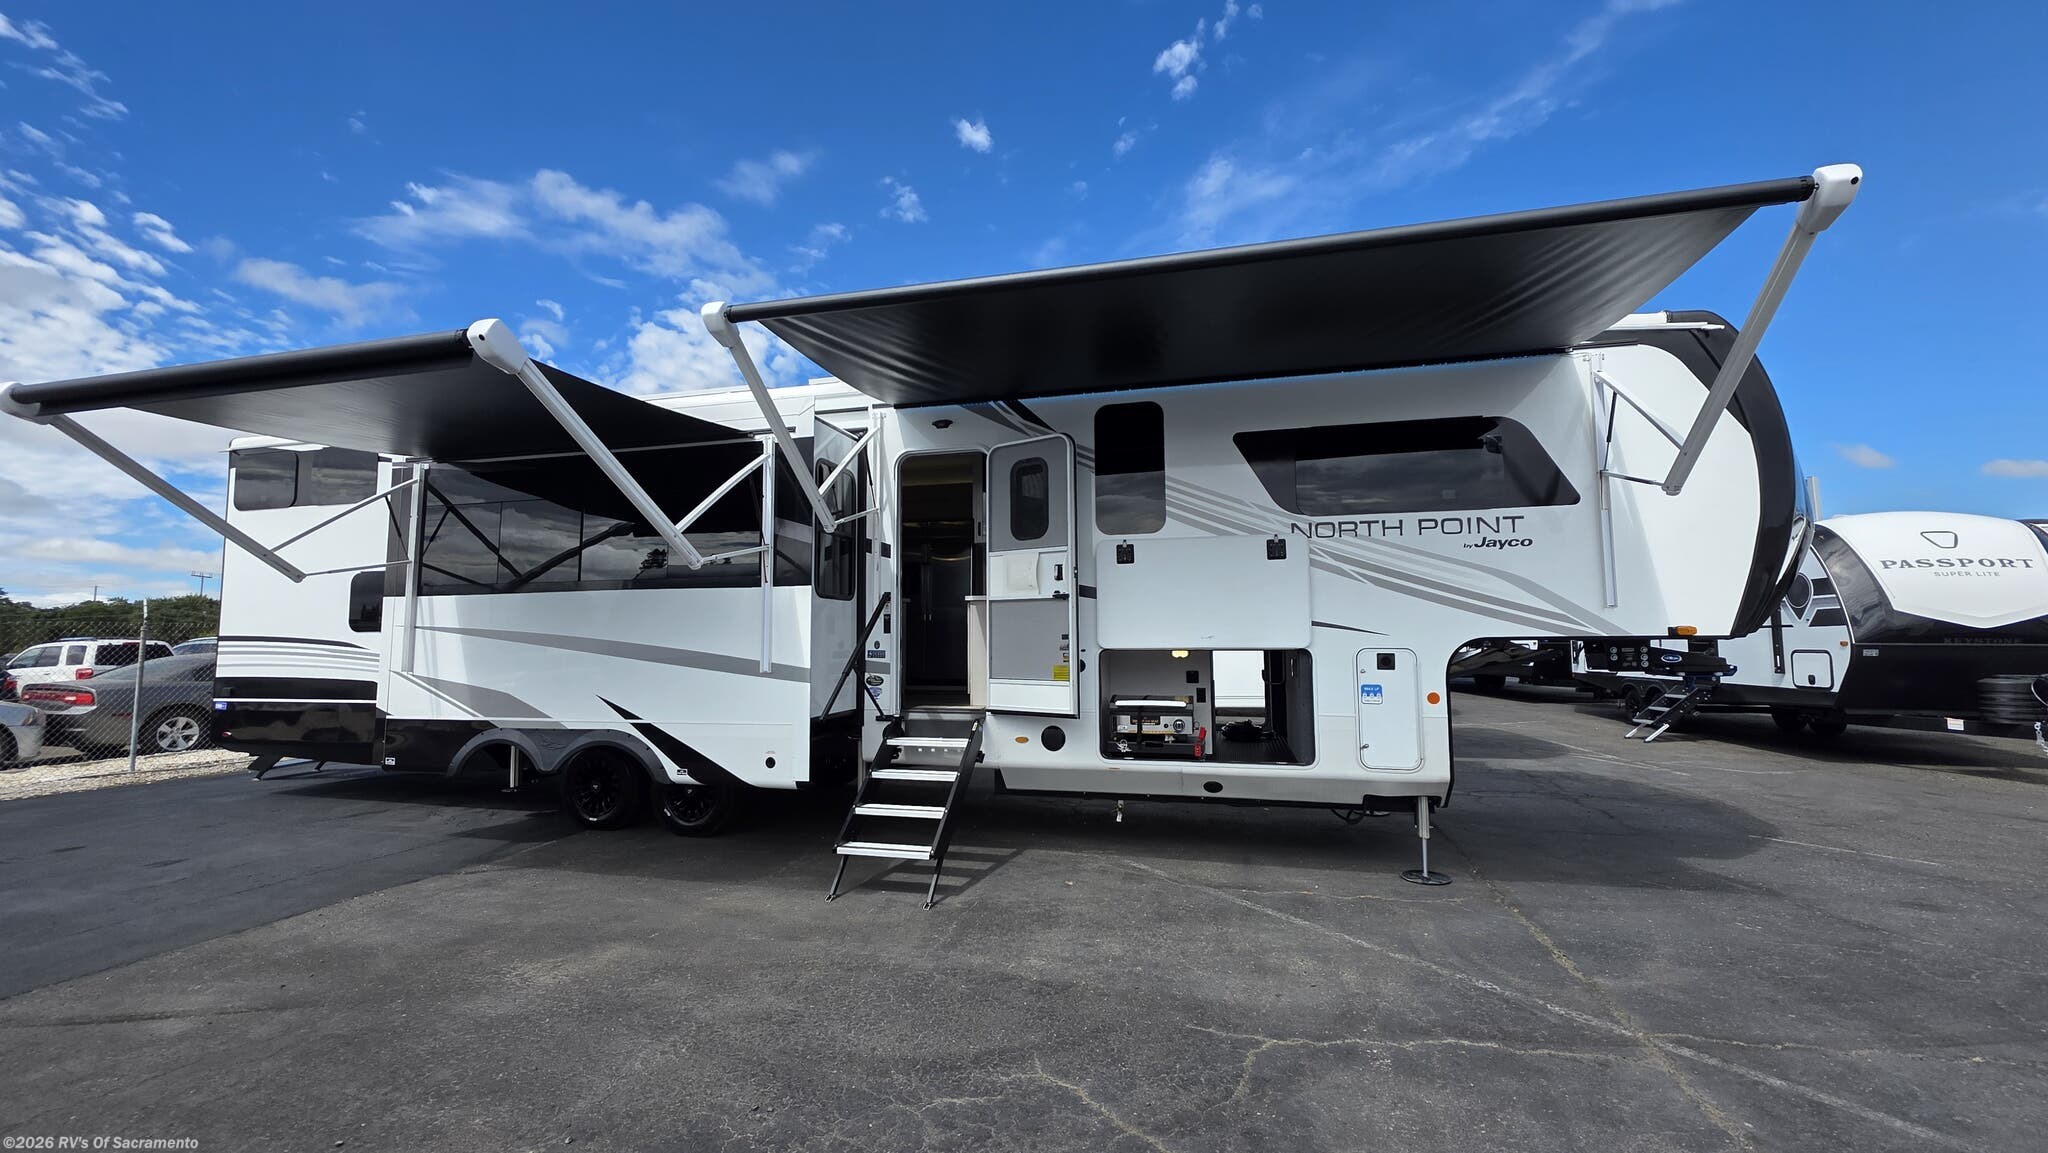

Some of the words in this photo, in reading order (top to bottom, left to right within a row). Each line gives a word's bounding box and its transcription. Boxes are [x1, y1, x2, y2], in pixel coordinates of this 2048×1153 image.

[1291, 519, 1403, 539] NORTH
[1418, 515, 1525, 536] POINT
[1474, 536, 1533, 550] Jayco
[1880, 558, 2034, 569] PASSPORT
